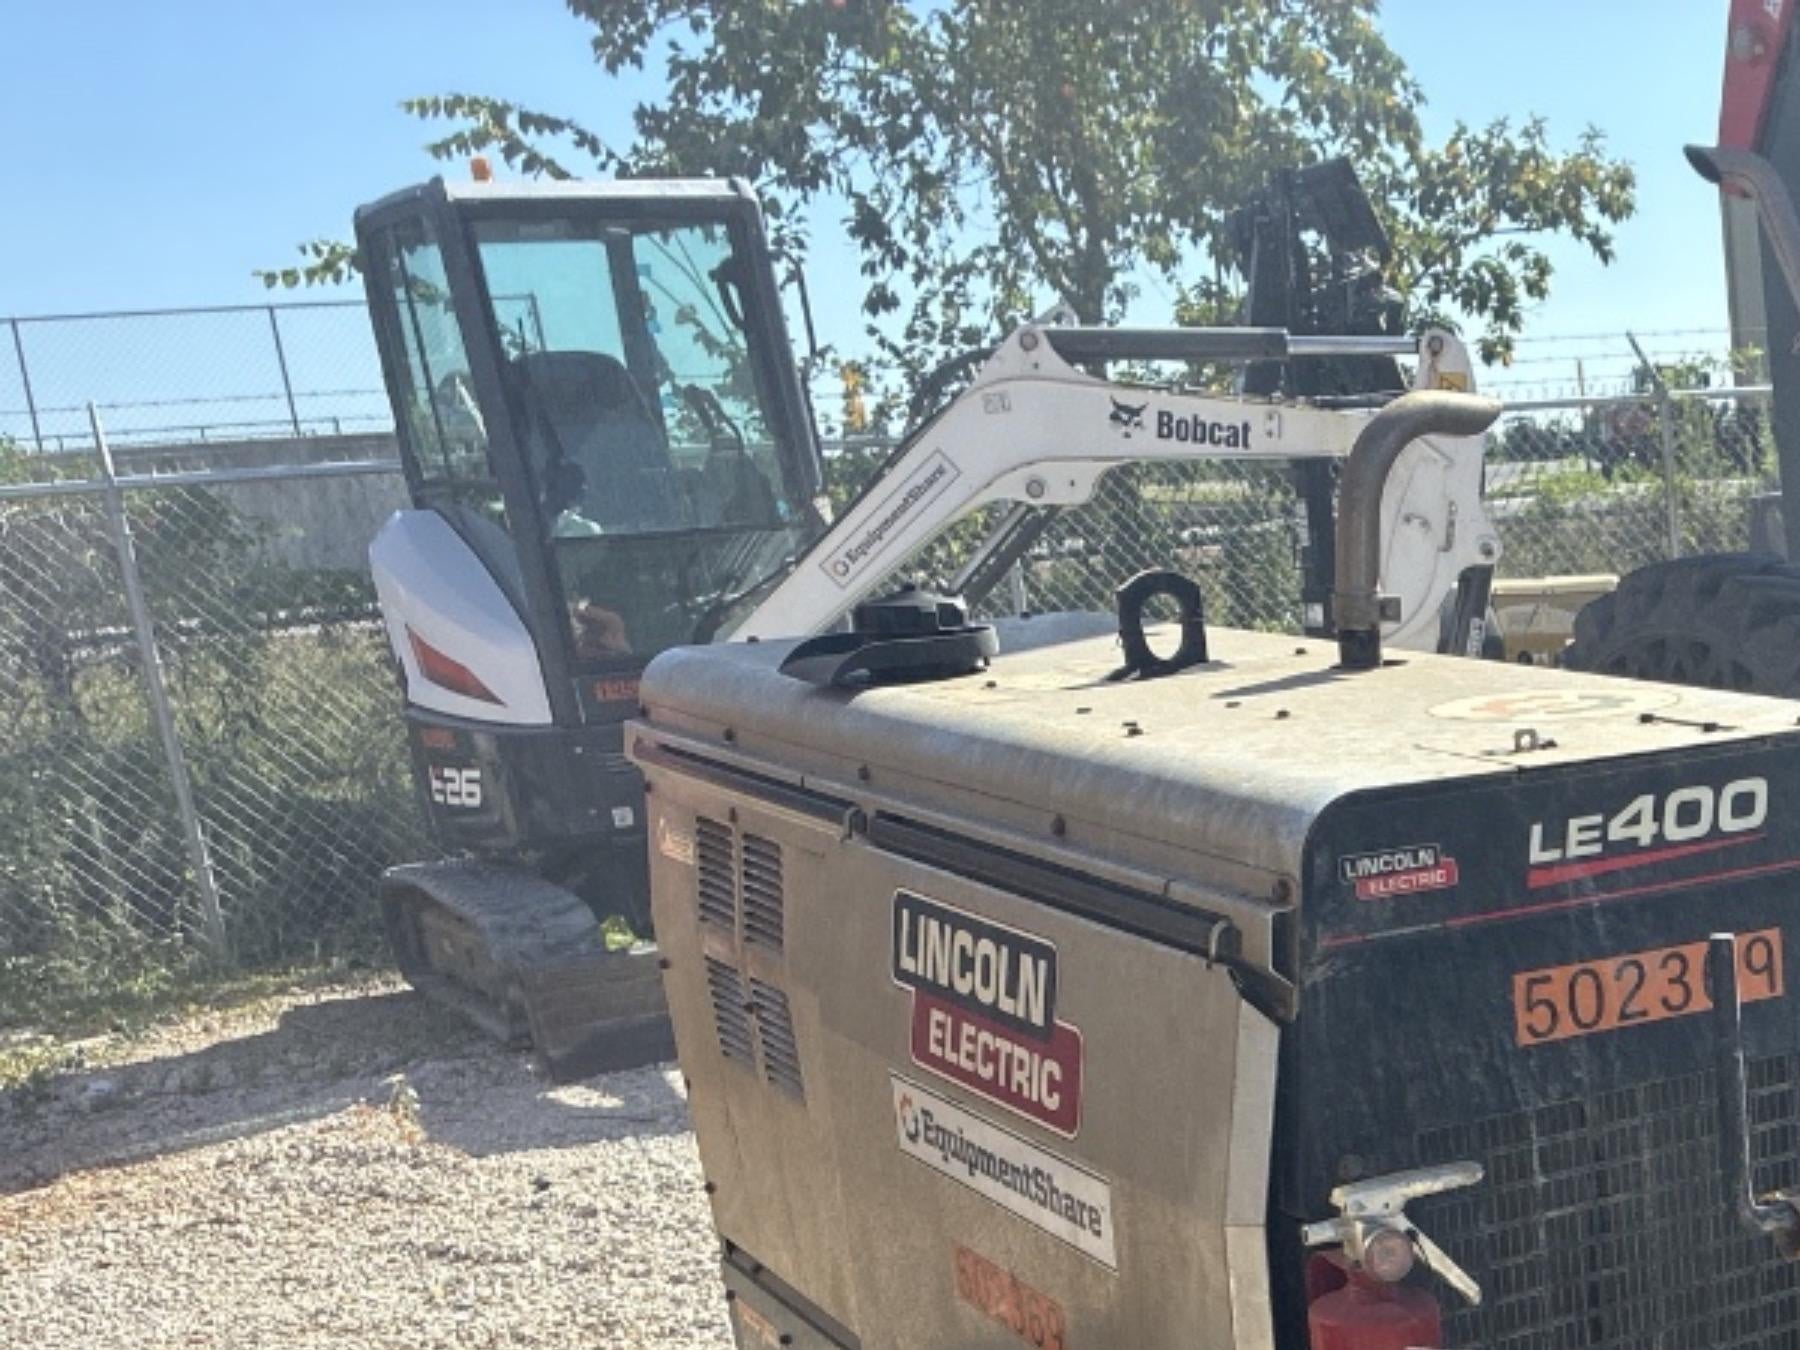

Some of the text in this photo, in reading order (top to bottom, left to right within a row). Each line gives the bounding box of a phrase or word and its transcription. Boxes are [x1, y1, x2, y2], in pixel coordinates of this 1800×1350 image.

[1157, 410, 1251, 450] Bobcat
[1343, 848, 1437, 880] LINCOLN
[1529, 777, 1769, 865] LE400
[1368, 869, 1448, 897] ELECTRIC
[900, 907, 1049, 1027] LINCOLN
[1524, 936, 1777, 1039] 50239
[928, 1007, 1062, 1111] ELECTRIC
[920, 1107, 1103, 1238] EquipmentShare
